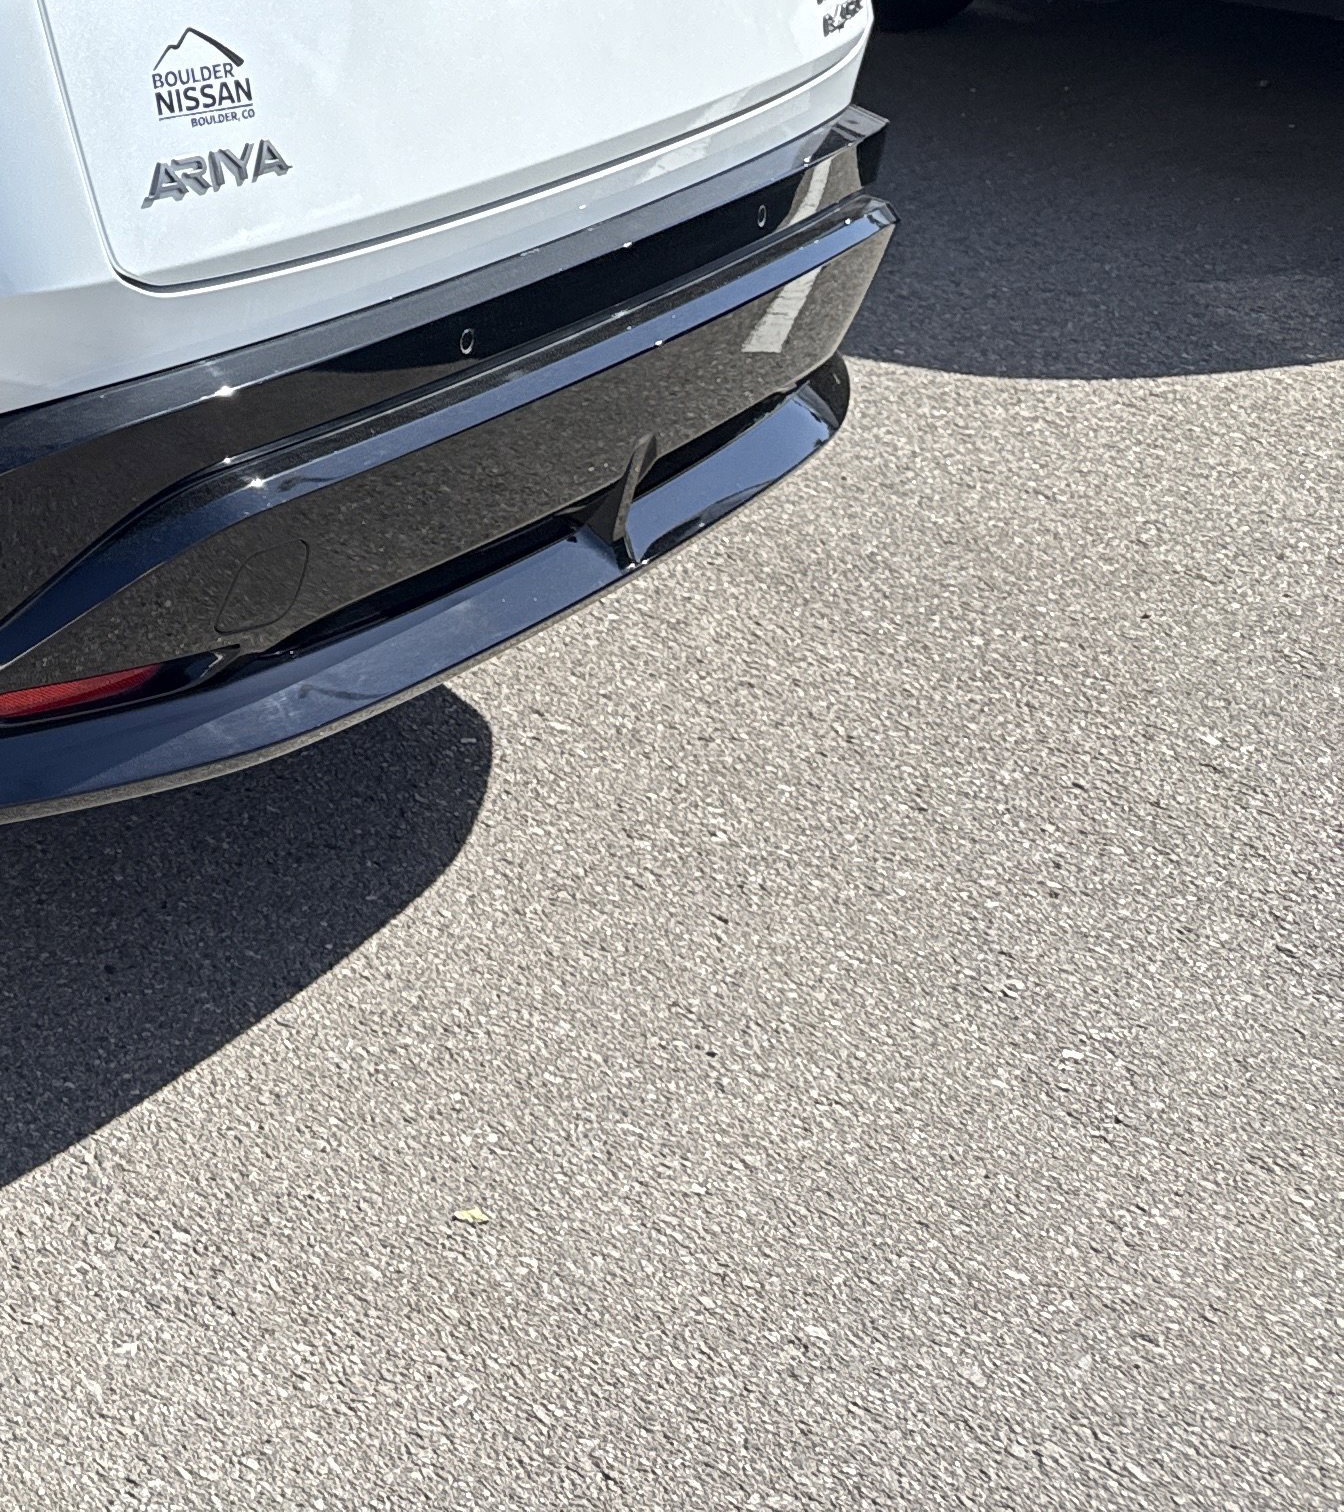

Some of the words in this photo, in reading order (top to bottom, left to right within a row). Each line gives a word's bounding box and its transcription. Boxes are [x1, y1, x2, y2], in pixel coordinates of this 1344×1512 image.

[151, 62, 236, 90] BOULDER
[154, 77, 253, 116] NISSAN
[190, 110, 241, 128] BOULDER,
[241, 108, 256, 120] CO
[141, 139, 293, 210] ARIYA
